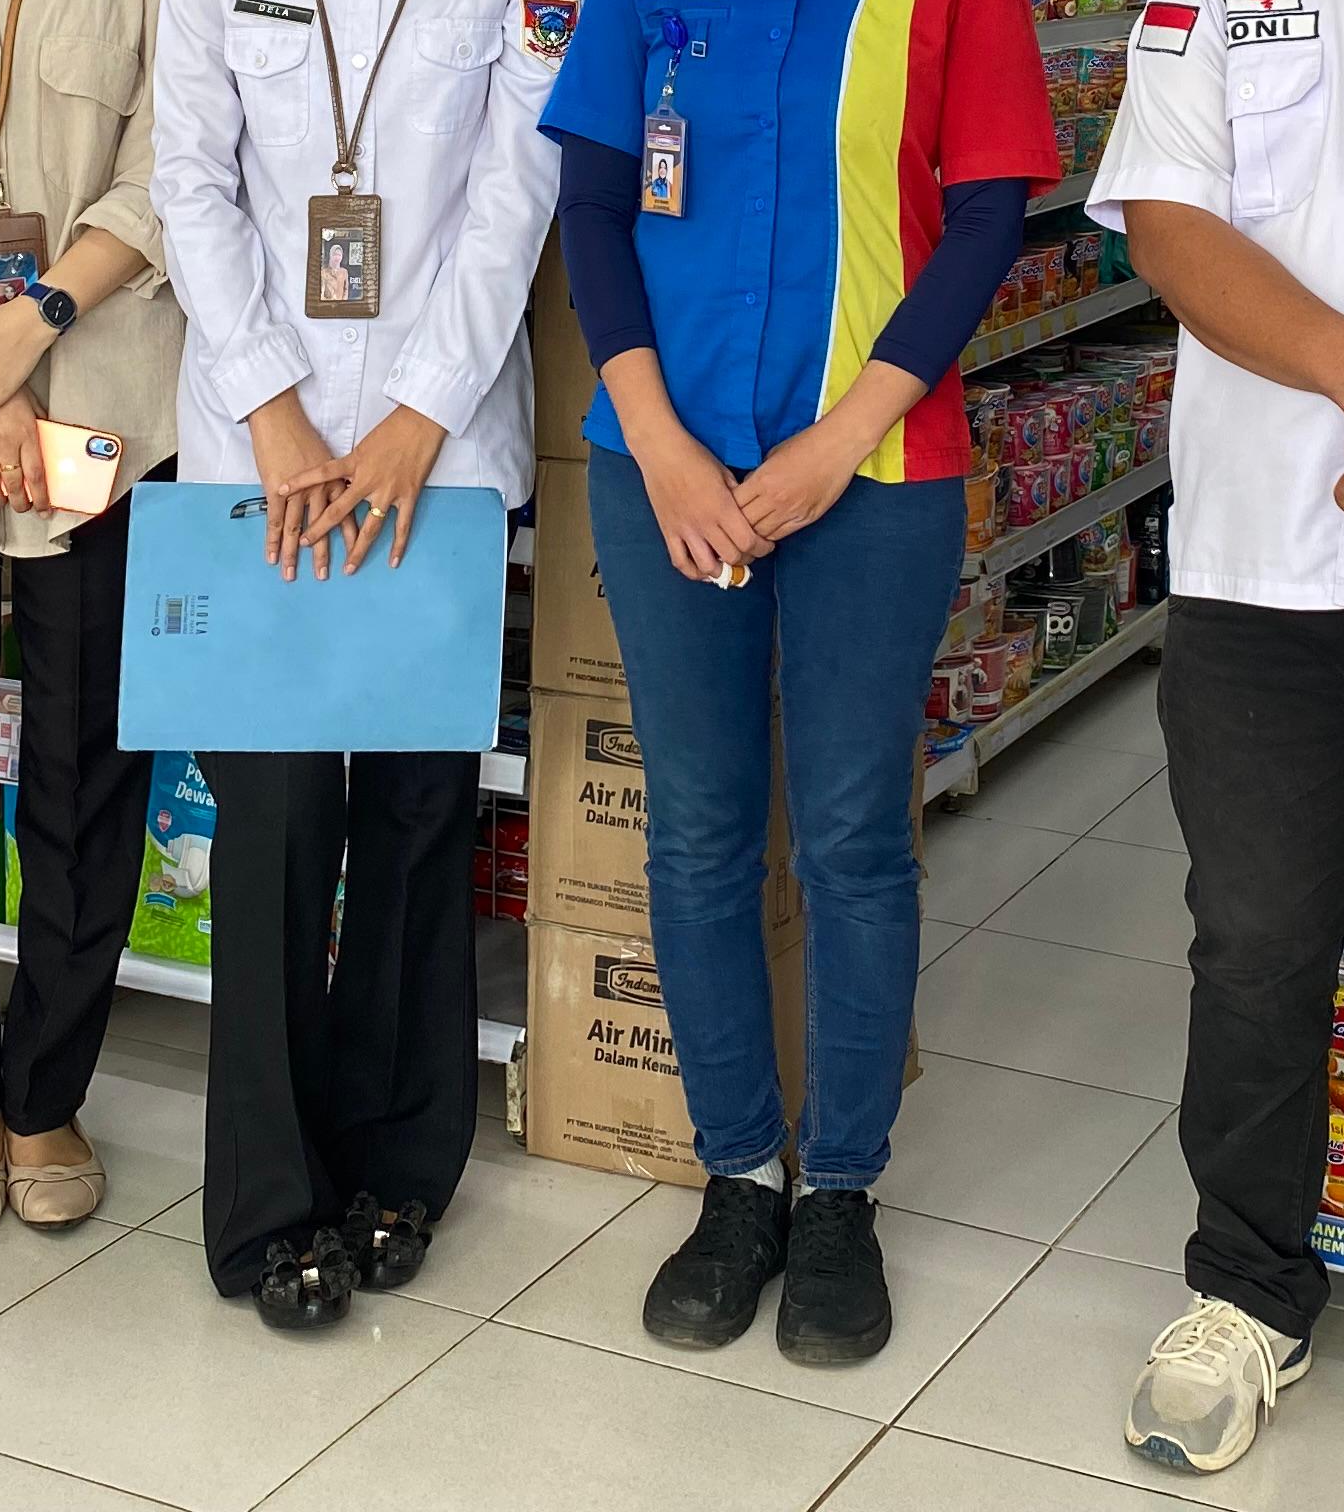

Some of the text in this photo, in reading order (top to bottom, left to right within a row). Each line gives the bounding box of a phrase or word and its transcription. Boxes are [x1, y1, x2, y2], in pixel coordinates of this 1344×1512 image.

[258, 2, 290, 17] DELA
[1225, 18, 1290, 41] ONI
[587, 1019, 625, 1045] Air
[594, 1048, 638, 1068] Dalam
